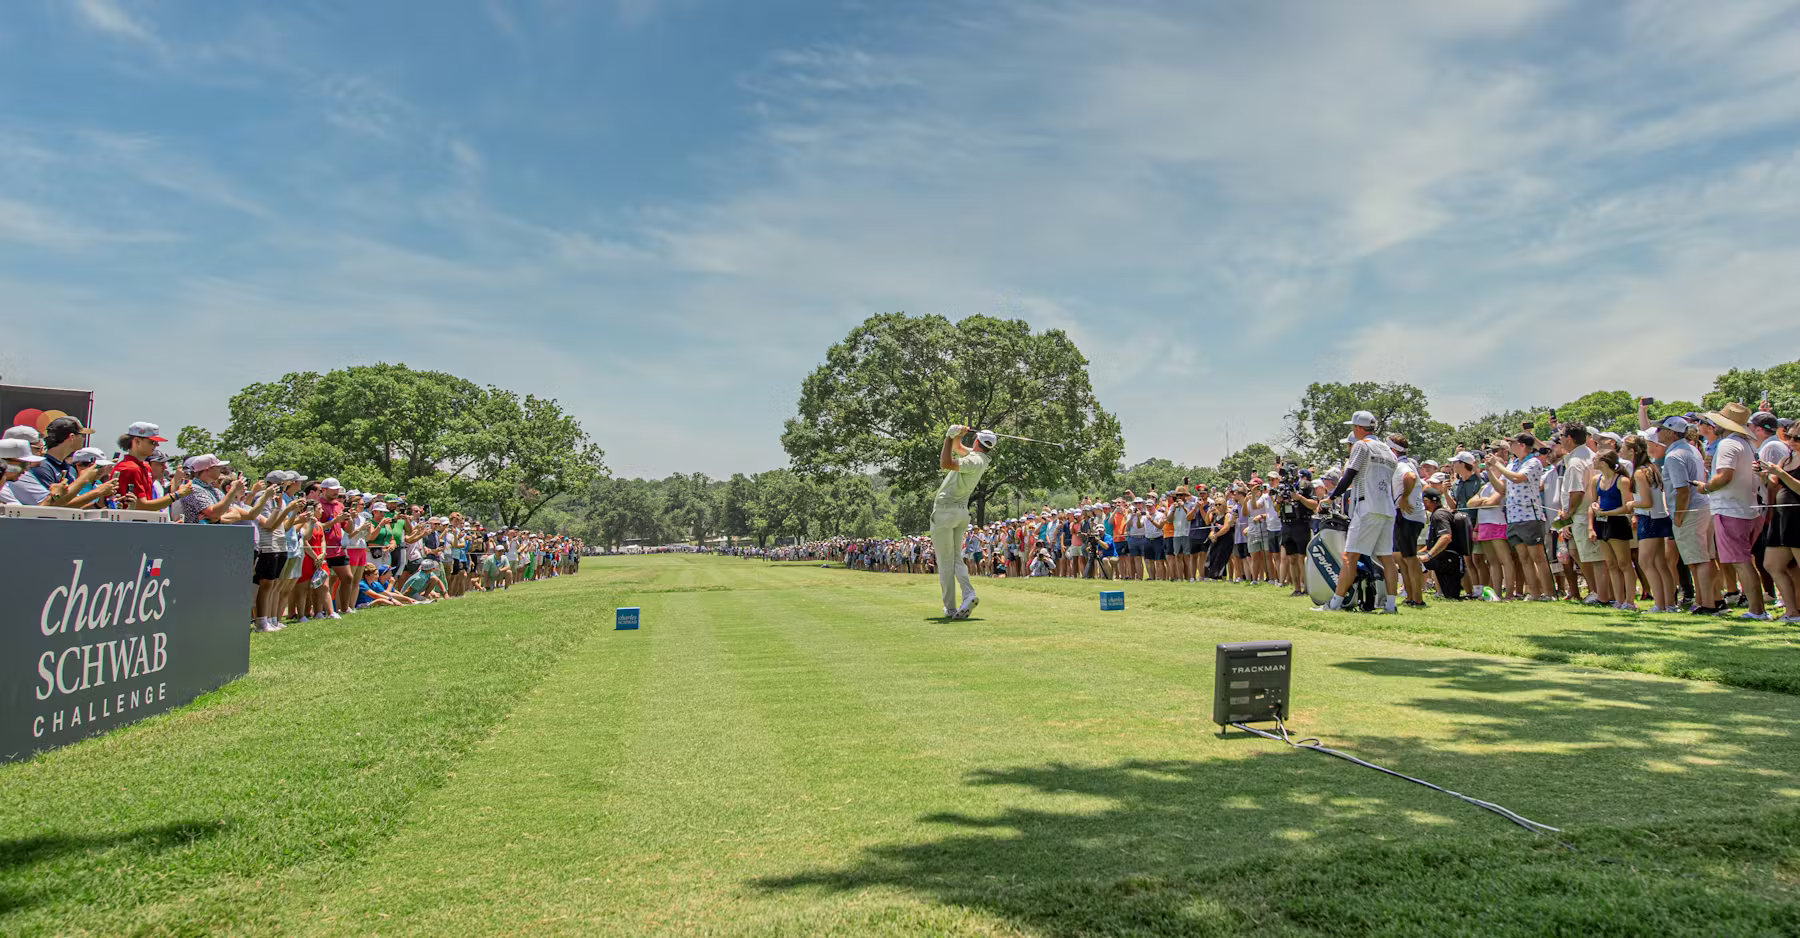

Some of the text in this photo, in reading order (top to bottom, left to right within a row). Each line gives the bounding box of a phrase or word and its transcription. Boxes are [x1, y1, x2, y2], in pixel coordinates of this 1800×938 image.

[41, 552, 170, 636] charles
[1312, 545, 1350, 597] TaylorMe
[36, 632, 168, 700] SCHWAB
[1232, 664, 1286, 674] TRACKMAN
[33, 683, 167, 738] CHALLENGE
